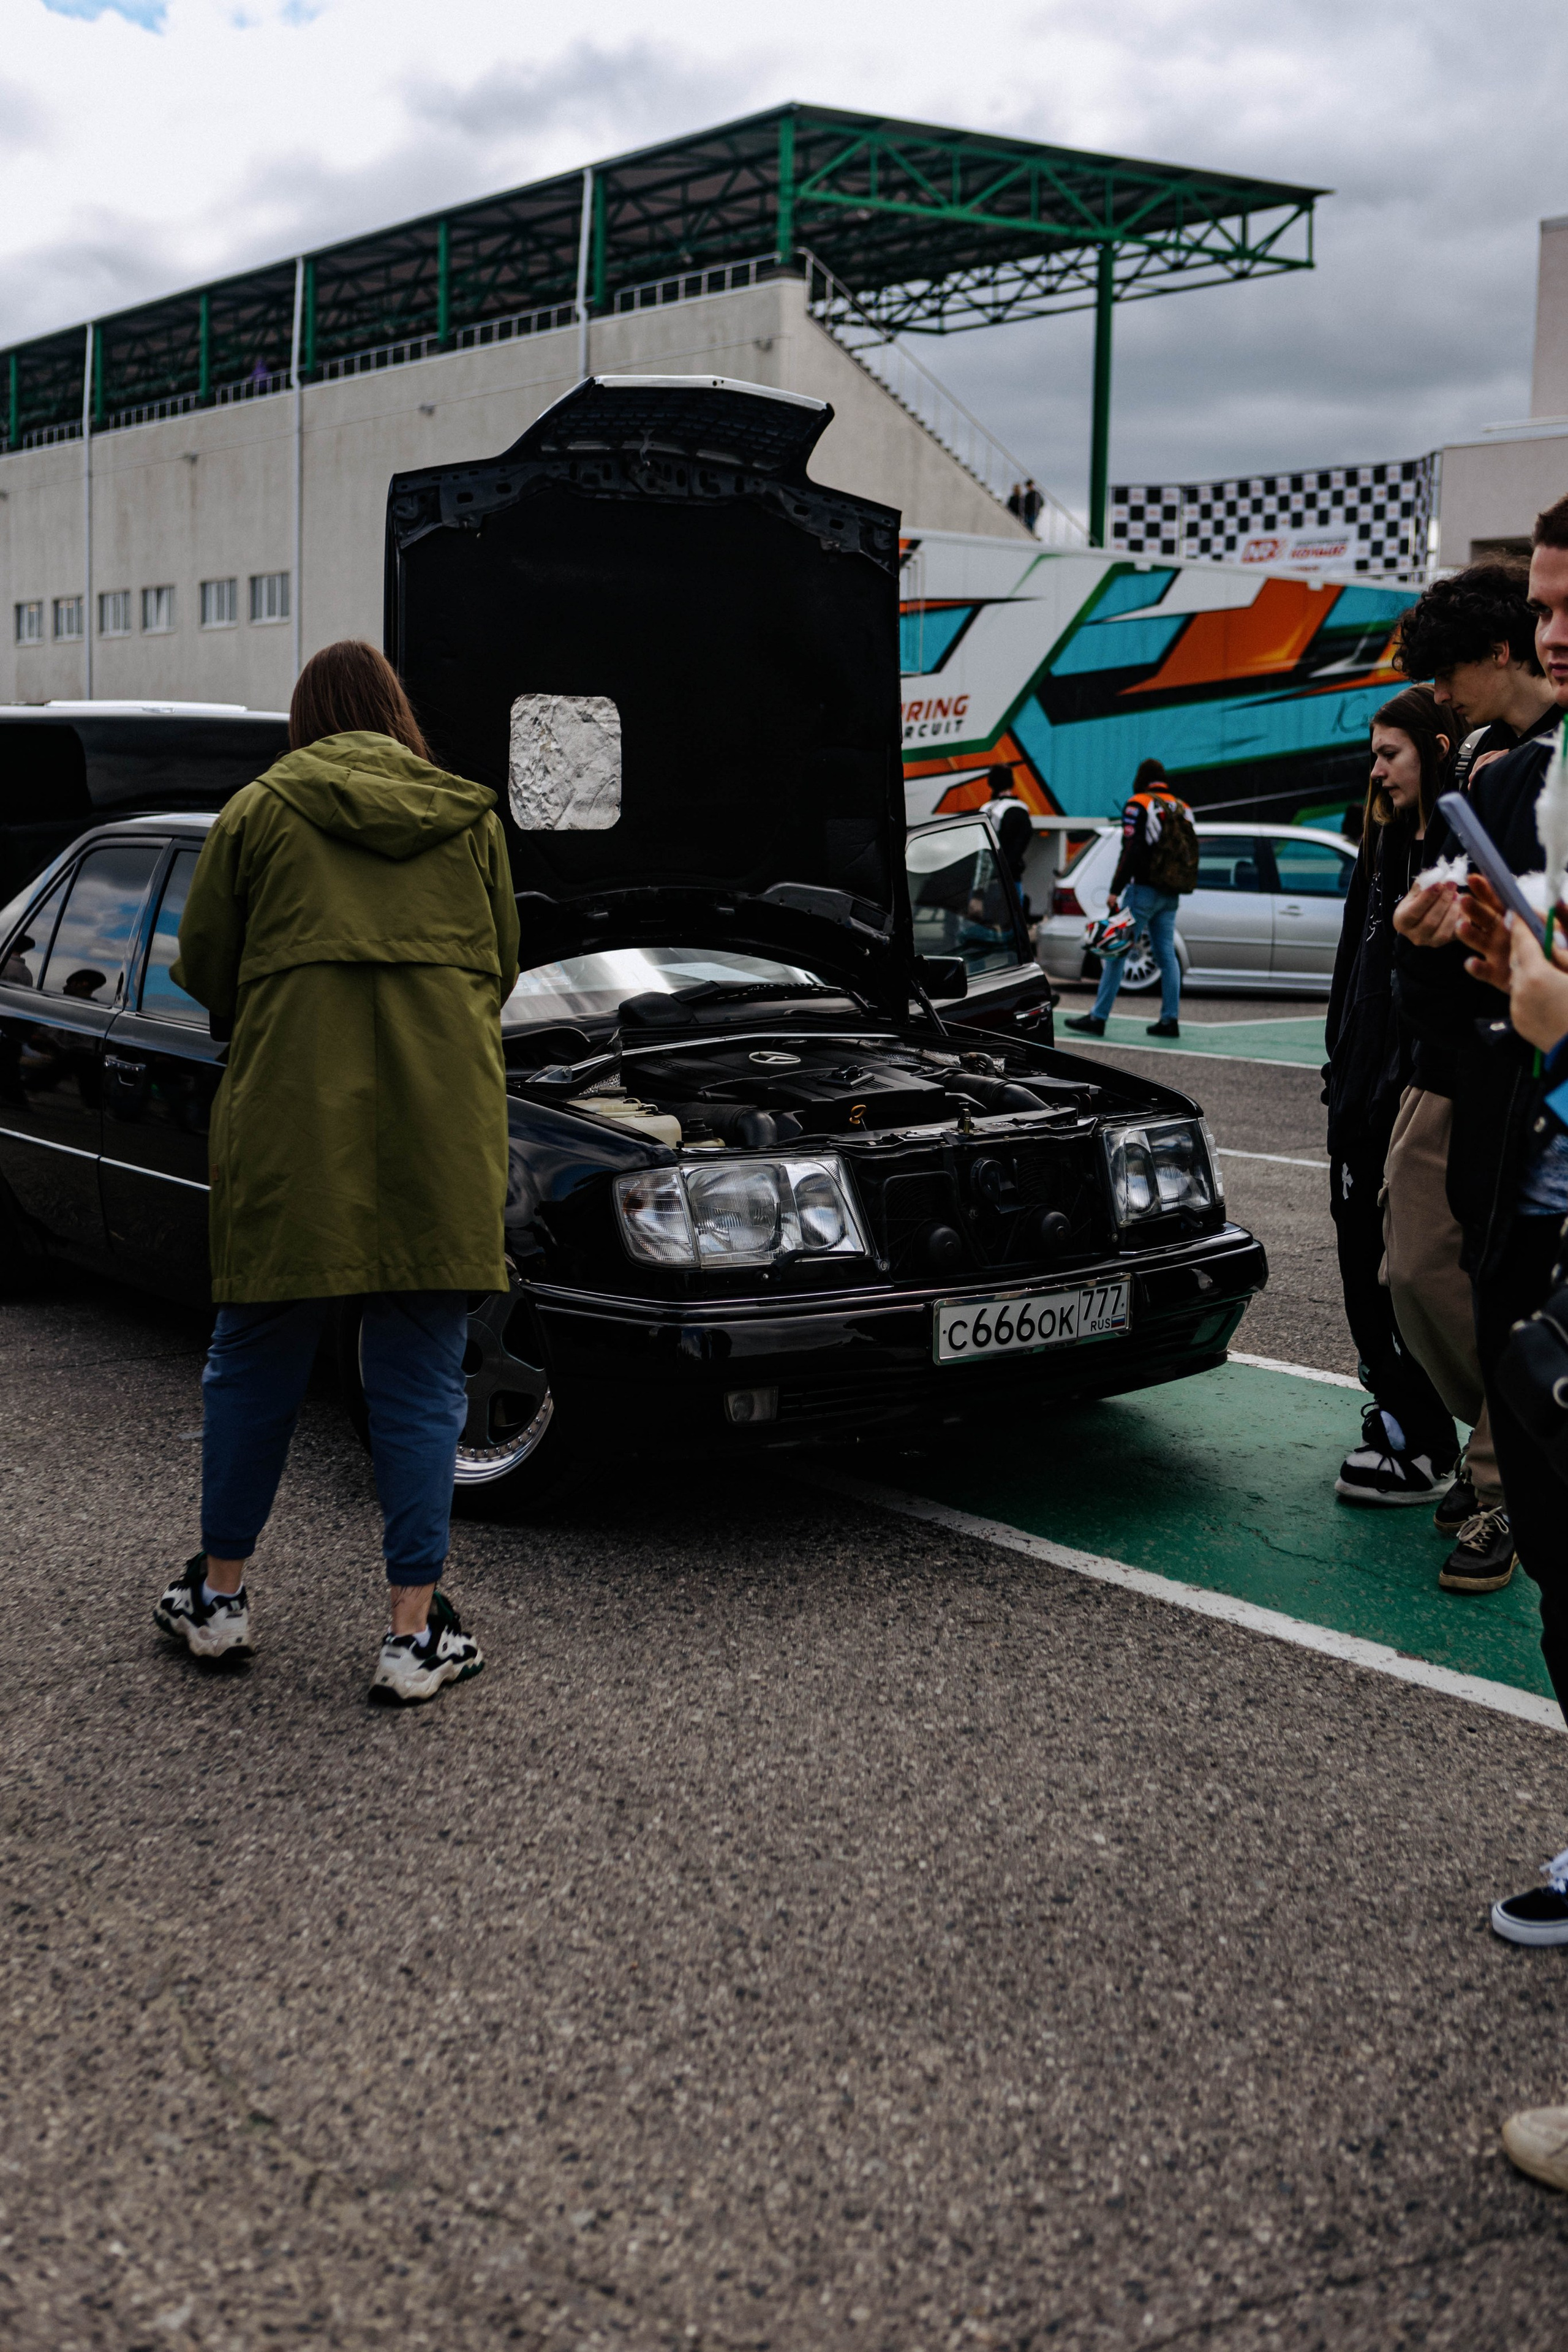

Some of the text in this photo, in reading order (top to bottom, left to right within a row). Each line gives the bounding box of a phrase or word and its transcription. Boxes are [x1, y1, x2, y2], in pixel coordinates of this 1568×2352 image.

[901, 695, 970, 722] RING
[1082, 1285, 1122, 1321] 777
[1090, 1318, 1110, 1332] RUS
